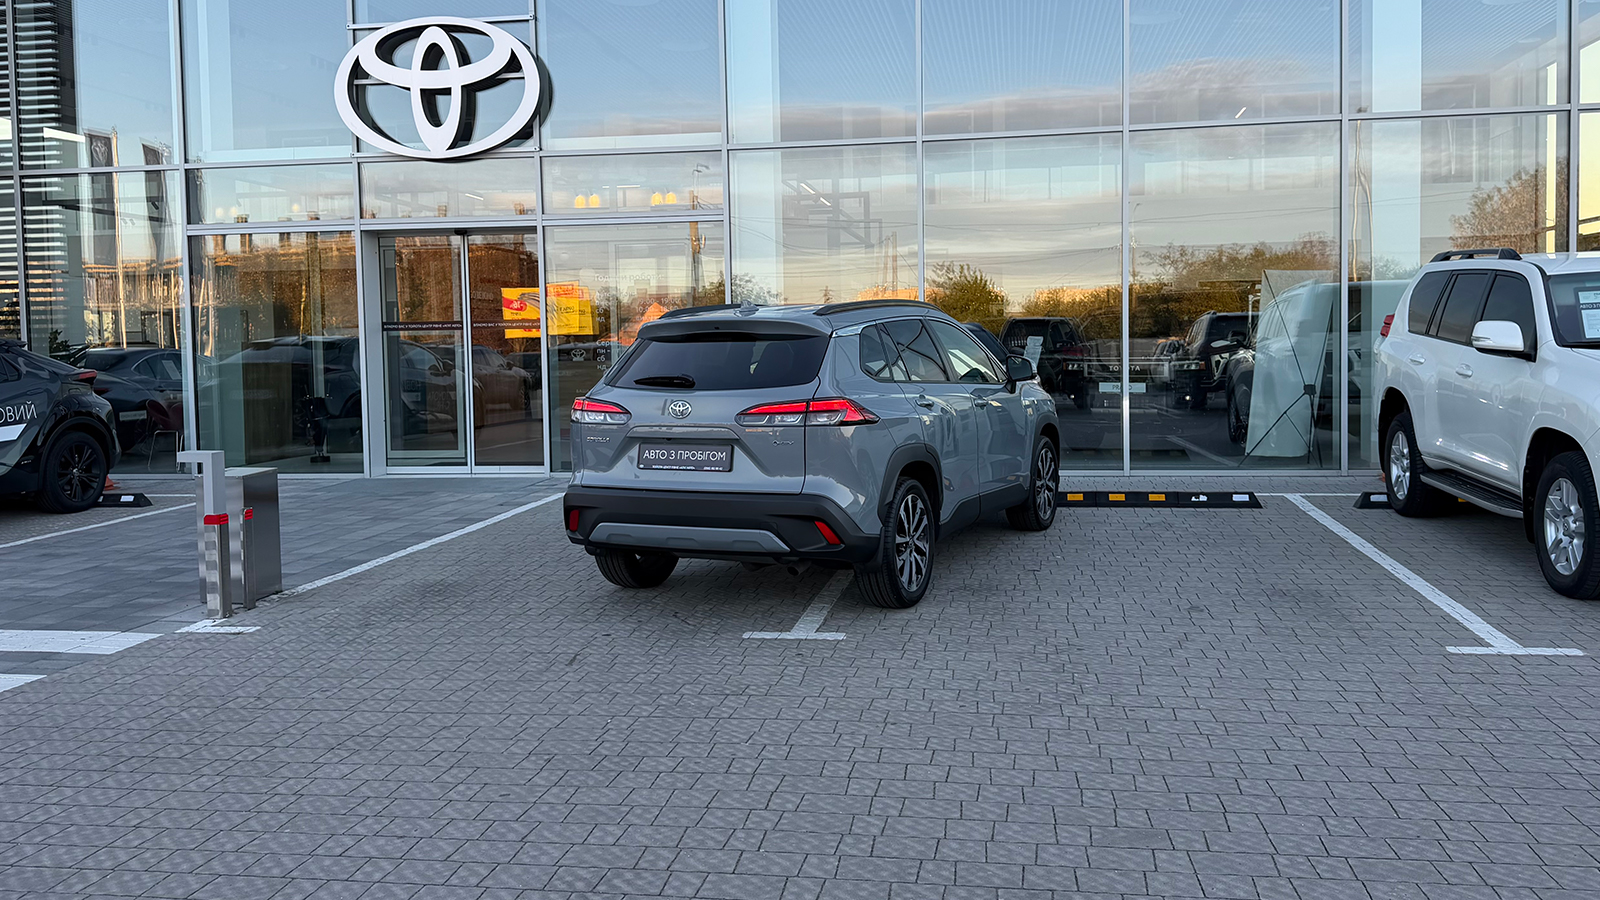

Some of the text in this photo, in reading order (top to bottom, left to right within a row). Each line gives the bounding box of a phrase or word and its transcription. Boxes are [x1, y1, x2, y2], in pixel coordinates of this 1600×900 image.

[643, 450, 726, 461] АВТО З ПРОБІГОМ
